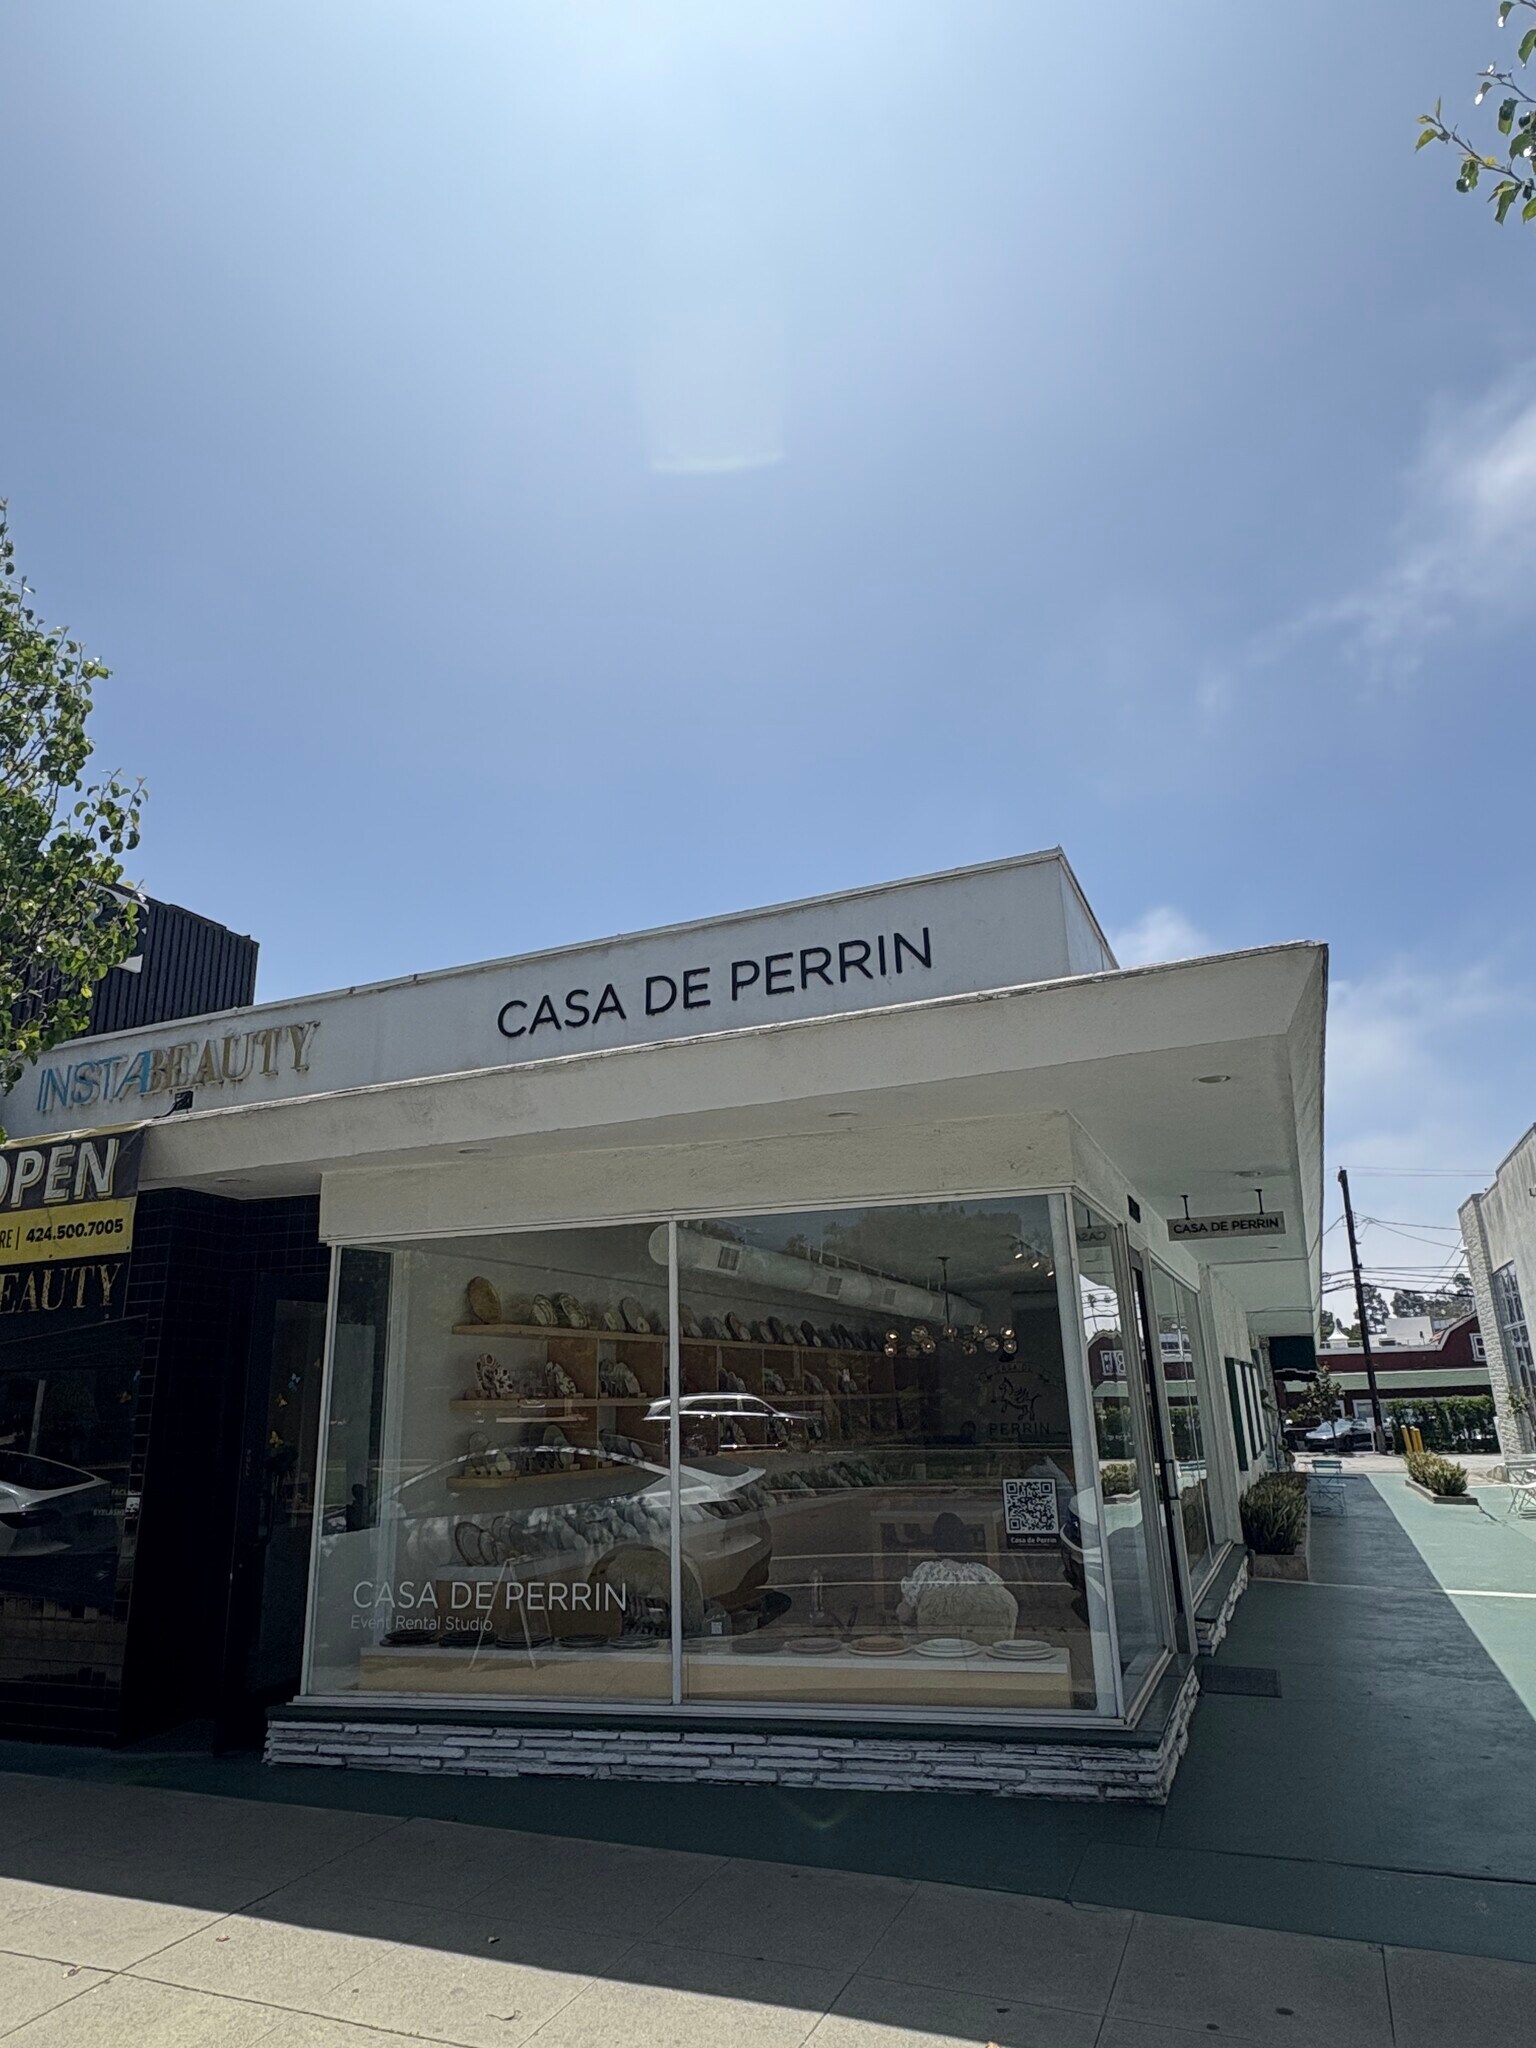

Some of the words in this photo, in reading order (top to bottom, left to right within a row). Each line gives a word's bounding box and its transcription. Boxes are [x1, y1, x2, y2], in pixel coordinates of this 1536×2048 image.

[497, 983, 627, 1038] CASA
[645, 967, 711, 1016] DE
[731, 927, 932, 1001] PERRIN
[26, 1218, 124, 1243] 424.500.7005
[1173, 1223, 1208, 1234] CASA
[1211, 1221, 1228, 1232] DE
[1232, 1218, 1279, 1230] PERRIN
[989, 1422, 1050, 1435] PERRIN
[1010, 1536, 1026, 1544] Casa
[1027, 1536, 1036, 1544] de
[1036, 1536, 1058, 1544] Perrin
[353, 1580, 439, 1610] CASA
[451, 1581, 494, 1611] DE
[505, 1581, 627, 1612] PERRIN
[350, 1614, 393, 1631] Event
[395, 1615, 441, 1631] Rental
[445, 1616, 494, 1632] Studio
